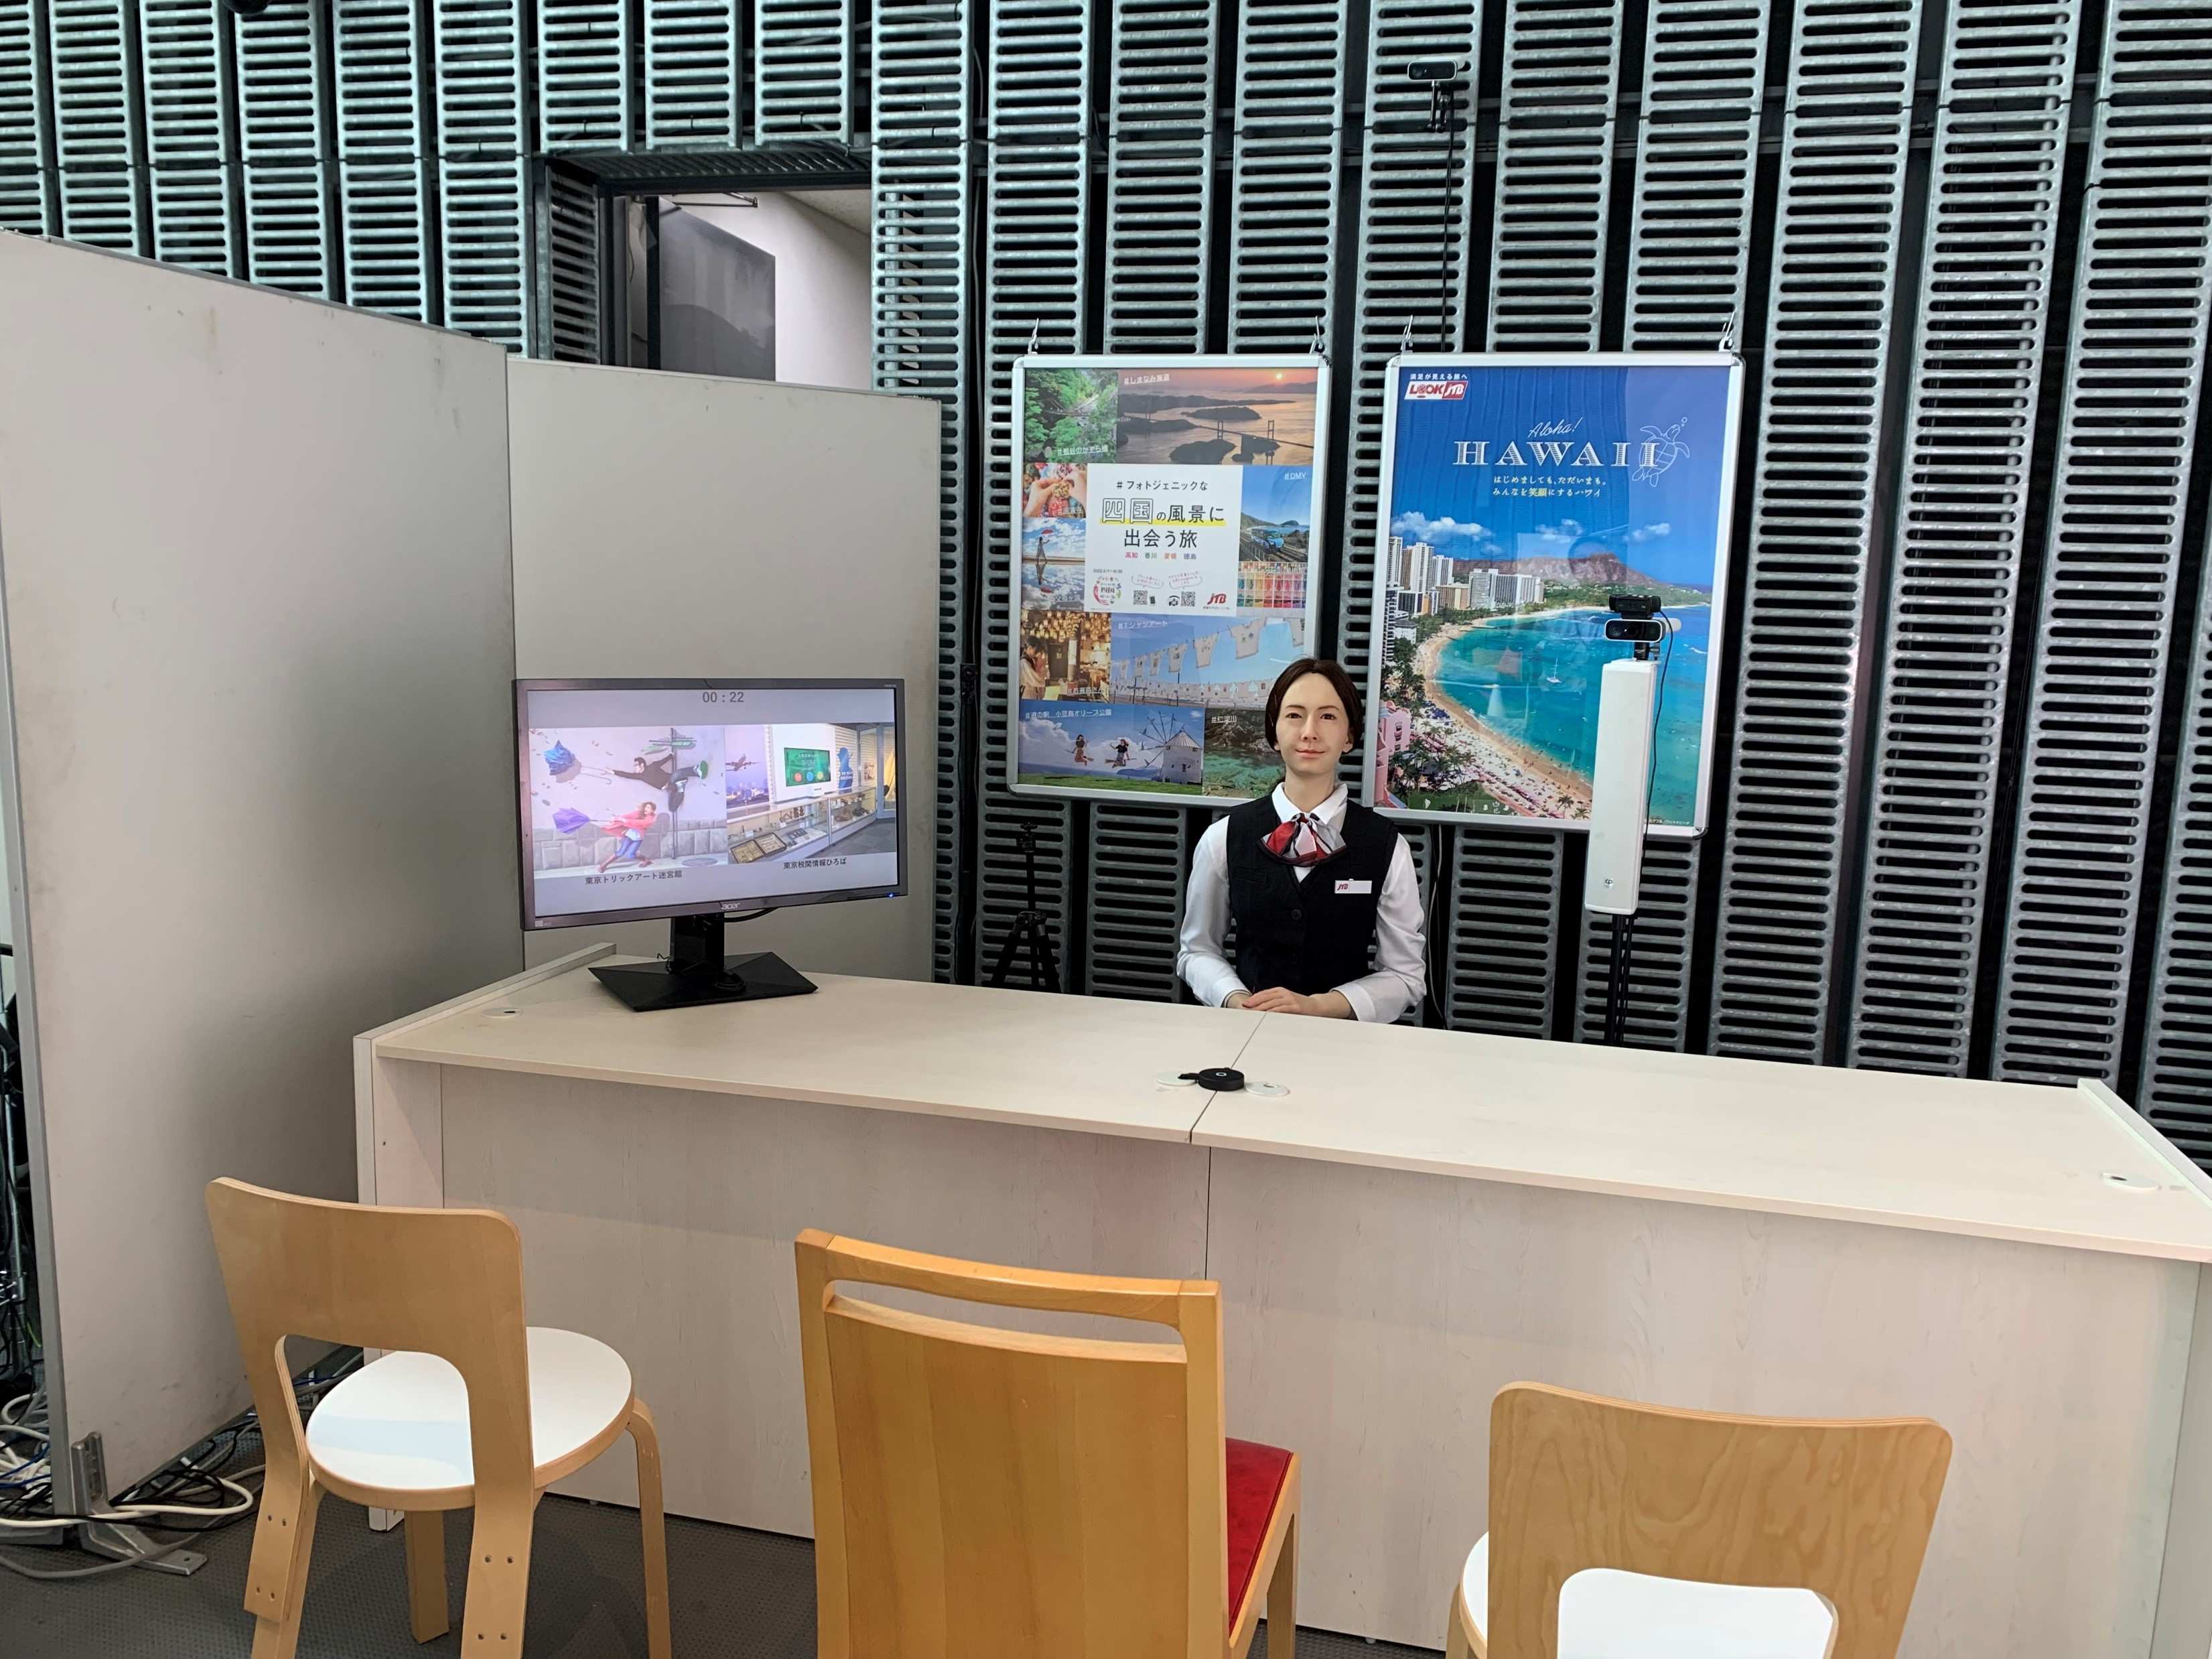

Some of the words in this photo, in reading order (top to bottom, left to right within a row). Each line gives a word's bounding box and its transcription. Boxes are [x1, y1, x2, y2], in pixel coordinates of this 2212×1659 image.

[1409, 384, 1444, 395] LOOK
[1444, 384, 1465, 397] JTB
[1527, 417, 1584, 438] Aloha!
[1452, 440, 1659, 467] HAWAII
[1102, 498, 1225, 524] 四国の風景に
[1124, 528, 1198, 548] 出会う旅
[1207, 593, 1227, 605] JTB
[783, 857, 847, 870] 東京税関情報ひろば
[585, 870, 683, 885] 東京トリックアート迷宮館
